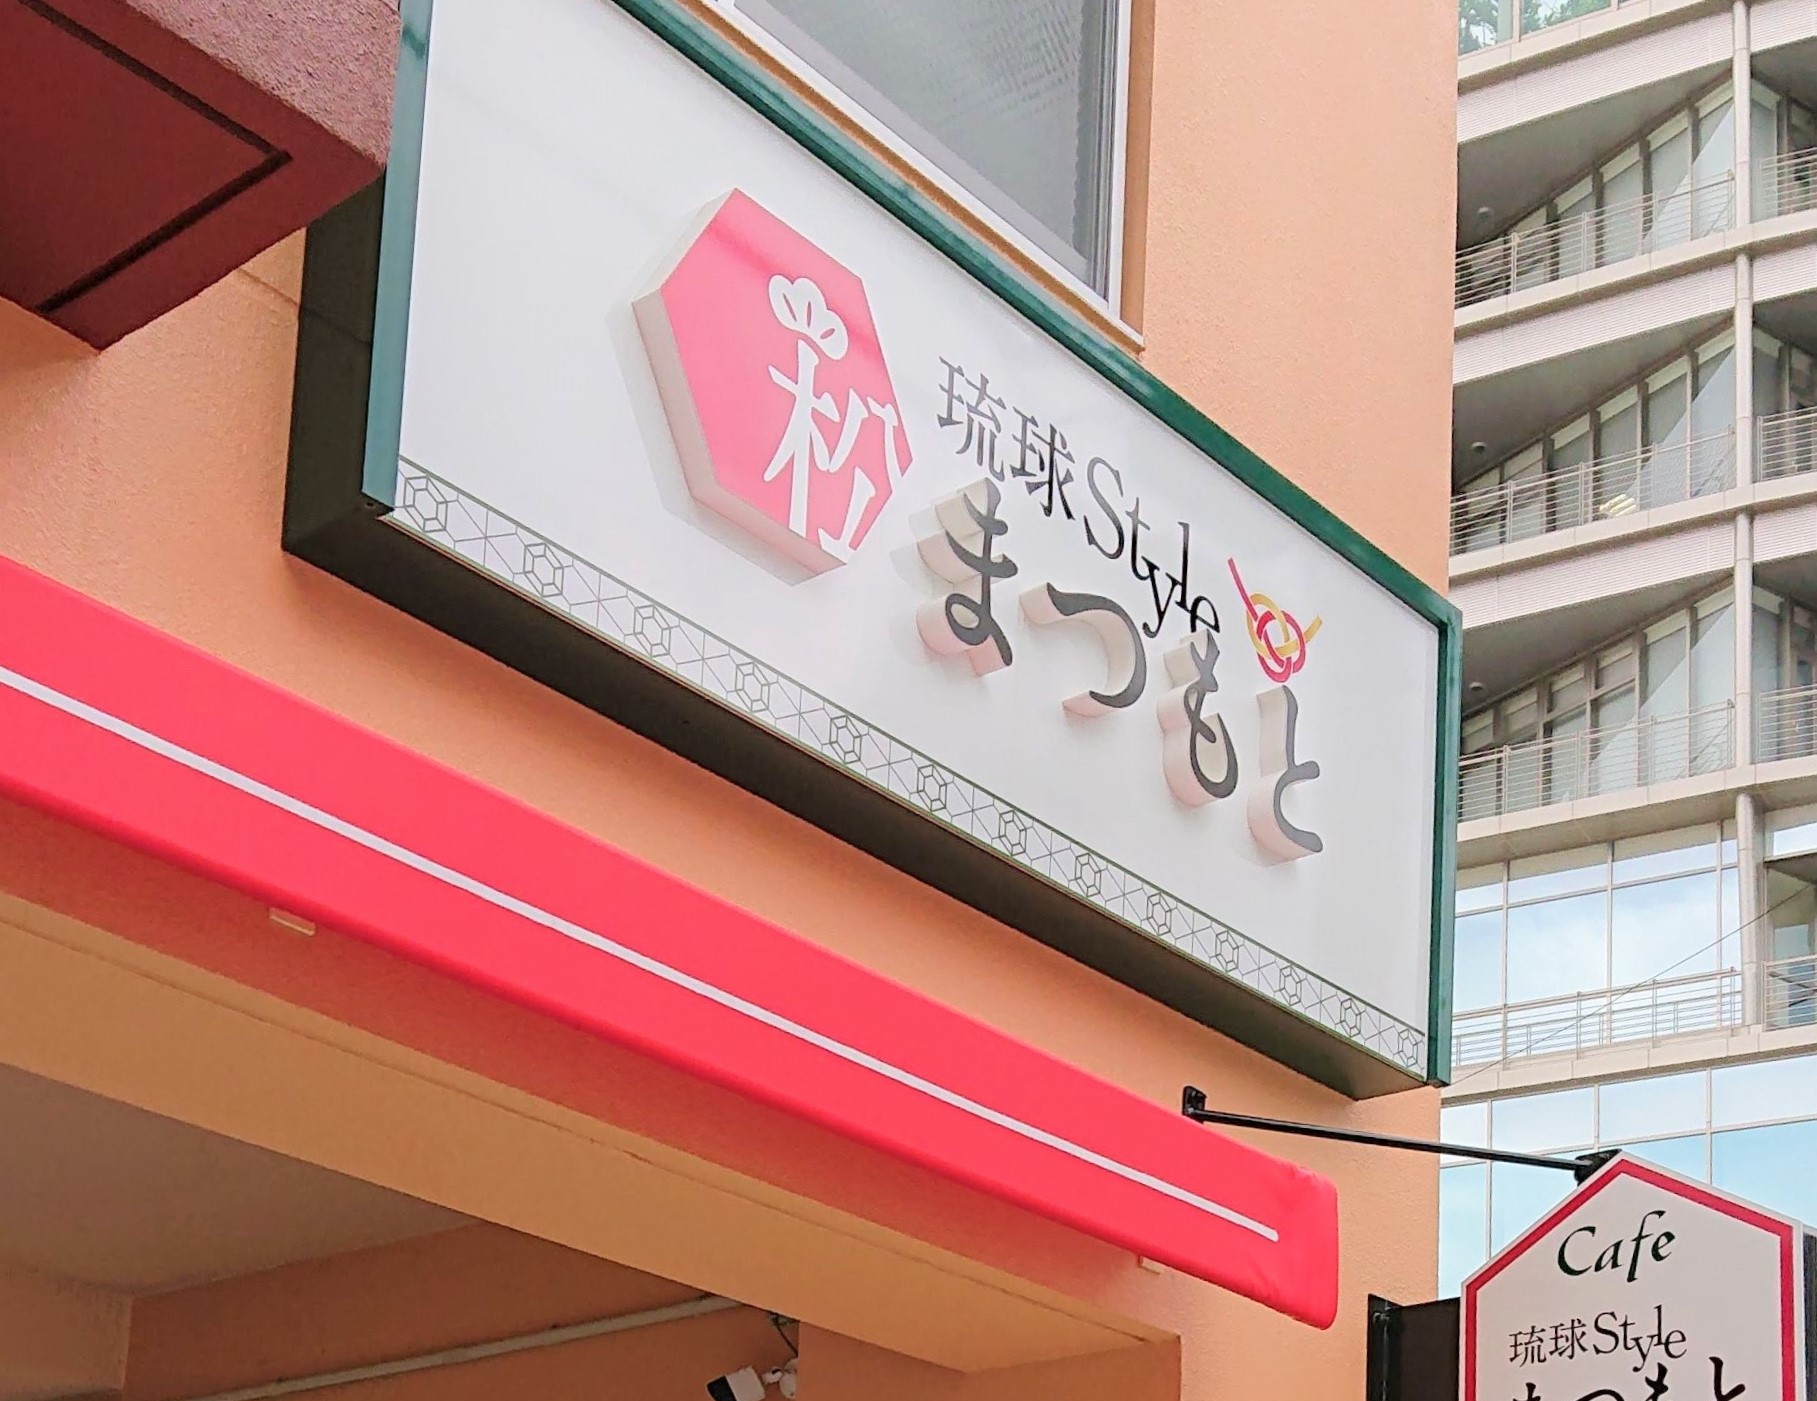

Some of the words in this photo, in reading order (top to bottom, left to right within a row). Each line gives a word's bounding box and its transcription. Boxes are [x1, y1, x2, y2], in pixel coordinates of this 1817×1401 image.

[945, 477, 1323, 852] まつもと
[1557, 1210, 1676, 1282] Cafe
